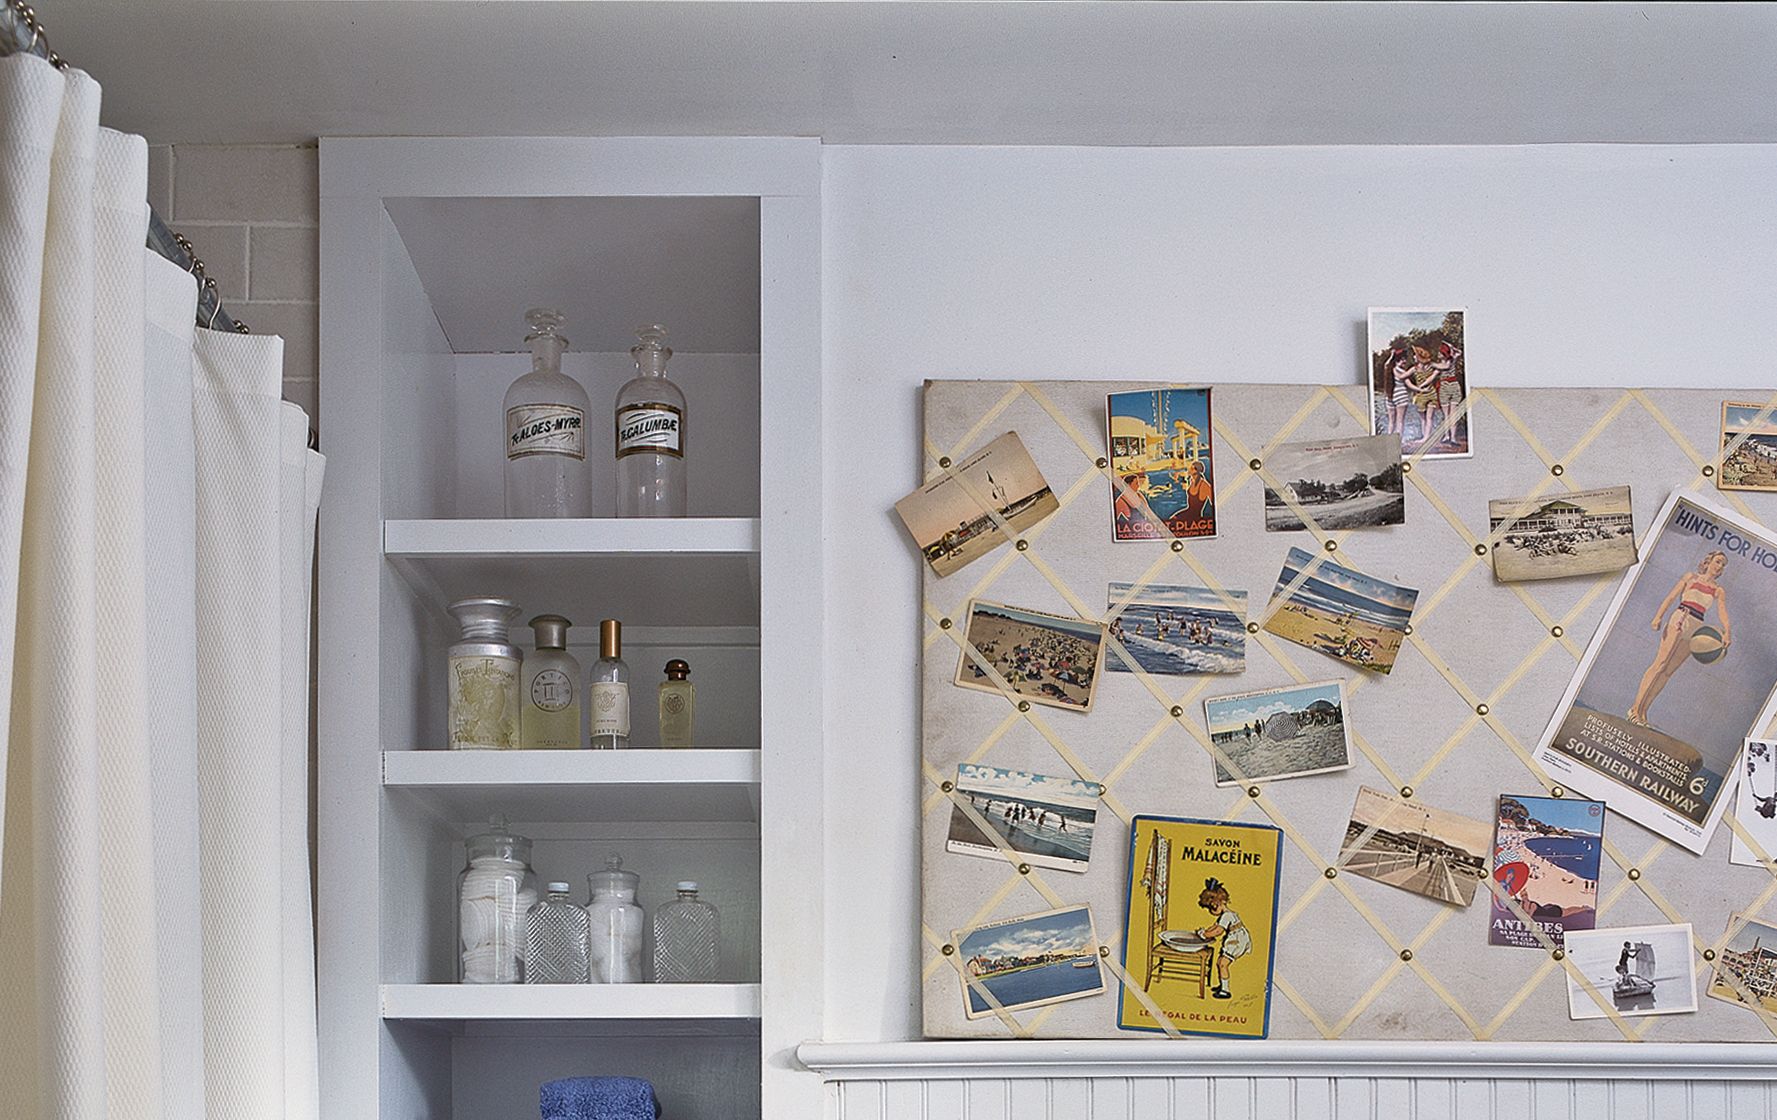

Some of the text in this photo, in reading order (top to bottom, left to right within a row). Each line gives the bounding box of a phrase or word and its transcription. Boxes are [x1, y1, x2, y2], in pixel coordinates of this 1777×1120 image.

[1117, 522, 1131, 533] LA
[1132, 519, 1213, 533] CIOT-PLAGE
[1718, 529, 1751, 557] FOR
[1584, 721, 1603, 736] LISTS
[1604, 731, 1615, 741] OF
[1615, 738, 1640, 755] HOTELS
[1587, 714, 1633, 742] PROFUSELY
[1580, 728, 1590, 737] AT
[1642, 760, 1684, 788] BOOKSTALLS
[1565, 737, 1639, 783] SOUTHERN
[1639, 775, 1700, 814] RAILWAY
[1205, 837, 1241, 848] SAVON
[1492, 918, 1564, 934] ANTBES
[1156, 1010, 1186, 1020] GAL
[1219, 1015, 1248, 1024] PEAU
